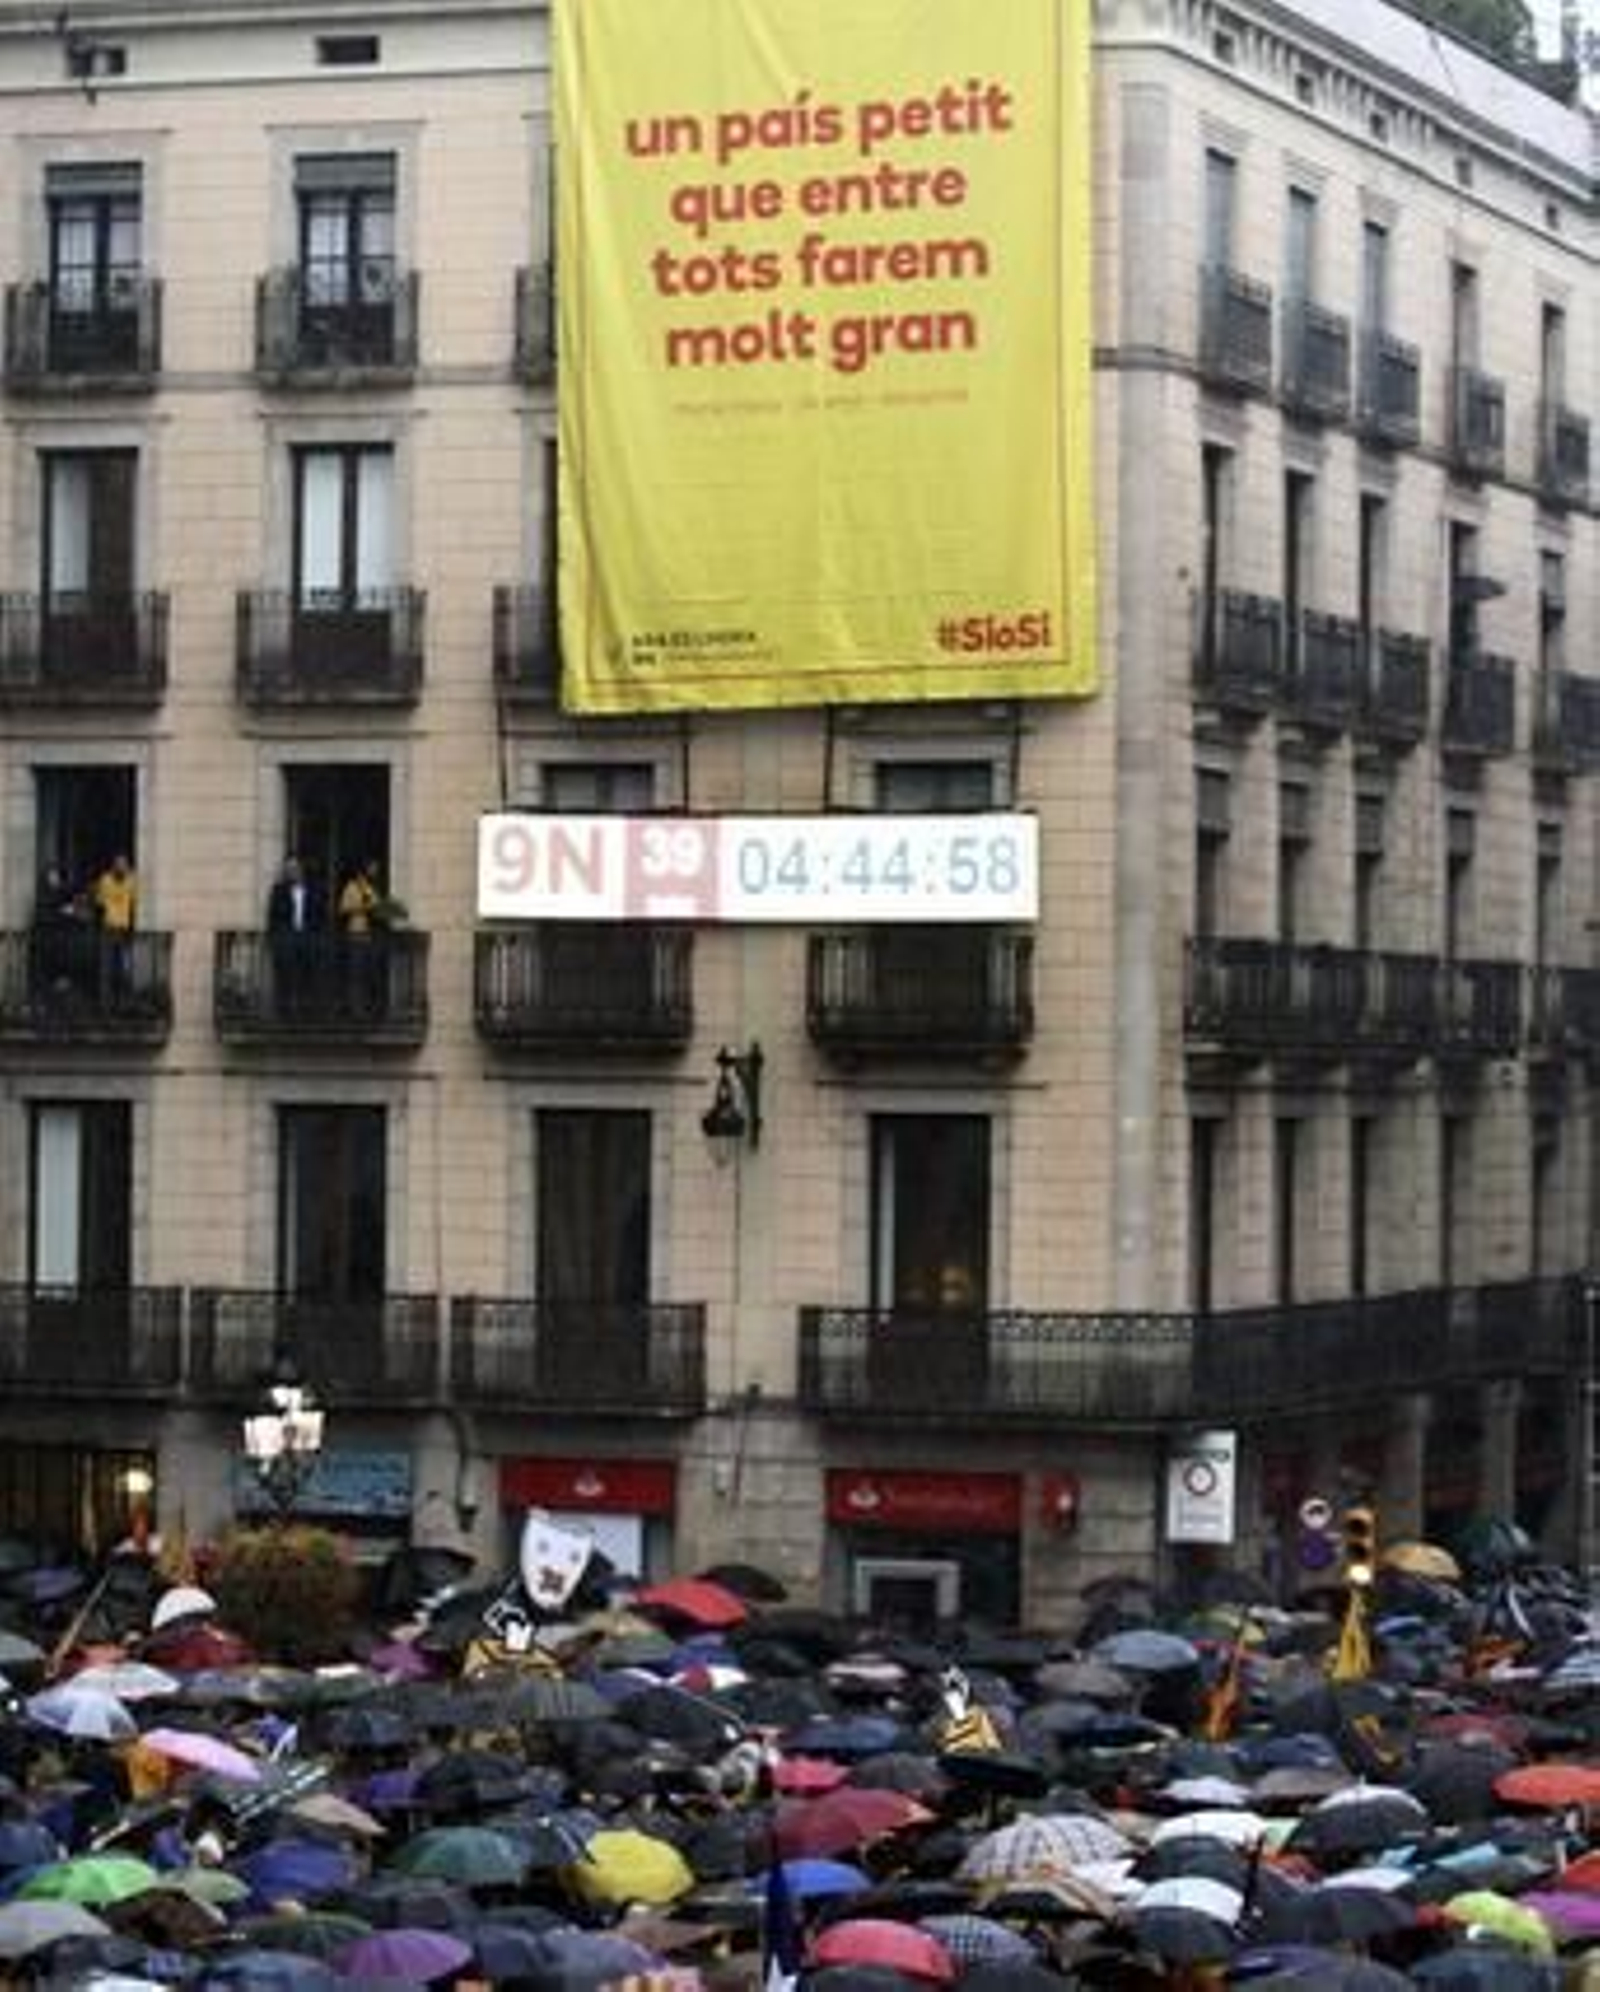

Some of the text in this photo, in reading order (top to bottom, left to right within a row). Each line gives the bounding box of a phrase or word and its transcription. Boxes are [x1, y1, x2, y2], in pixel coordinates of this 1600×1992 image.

[625, 79, 1014, 165] un país petit
[669, 162, 968, 239] que entre
[651, 234, 990, 296] tots farem
[666, 309, 977, 374] molt gran
[491, 824, 1021, 895] 9N 39 04:44:58
